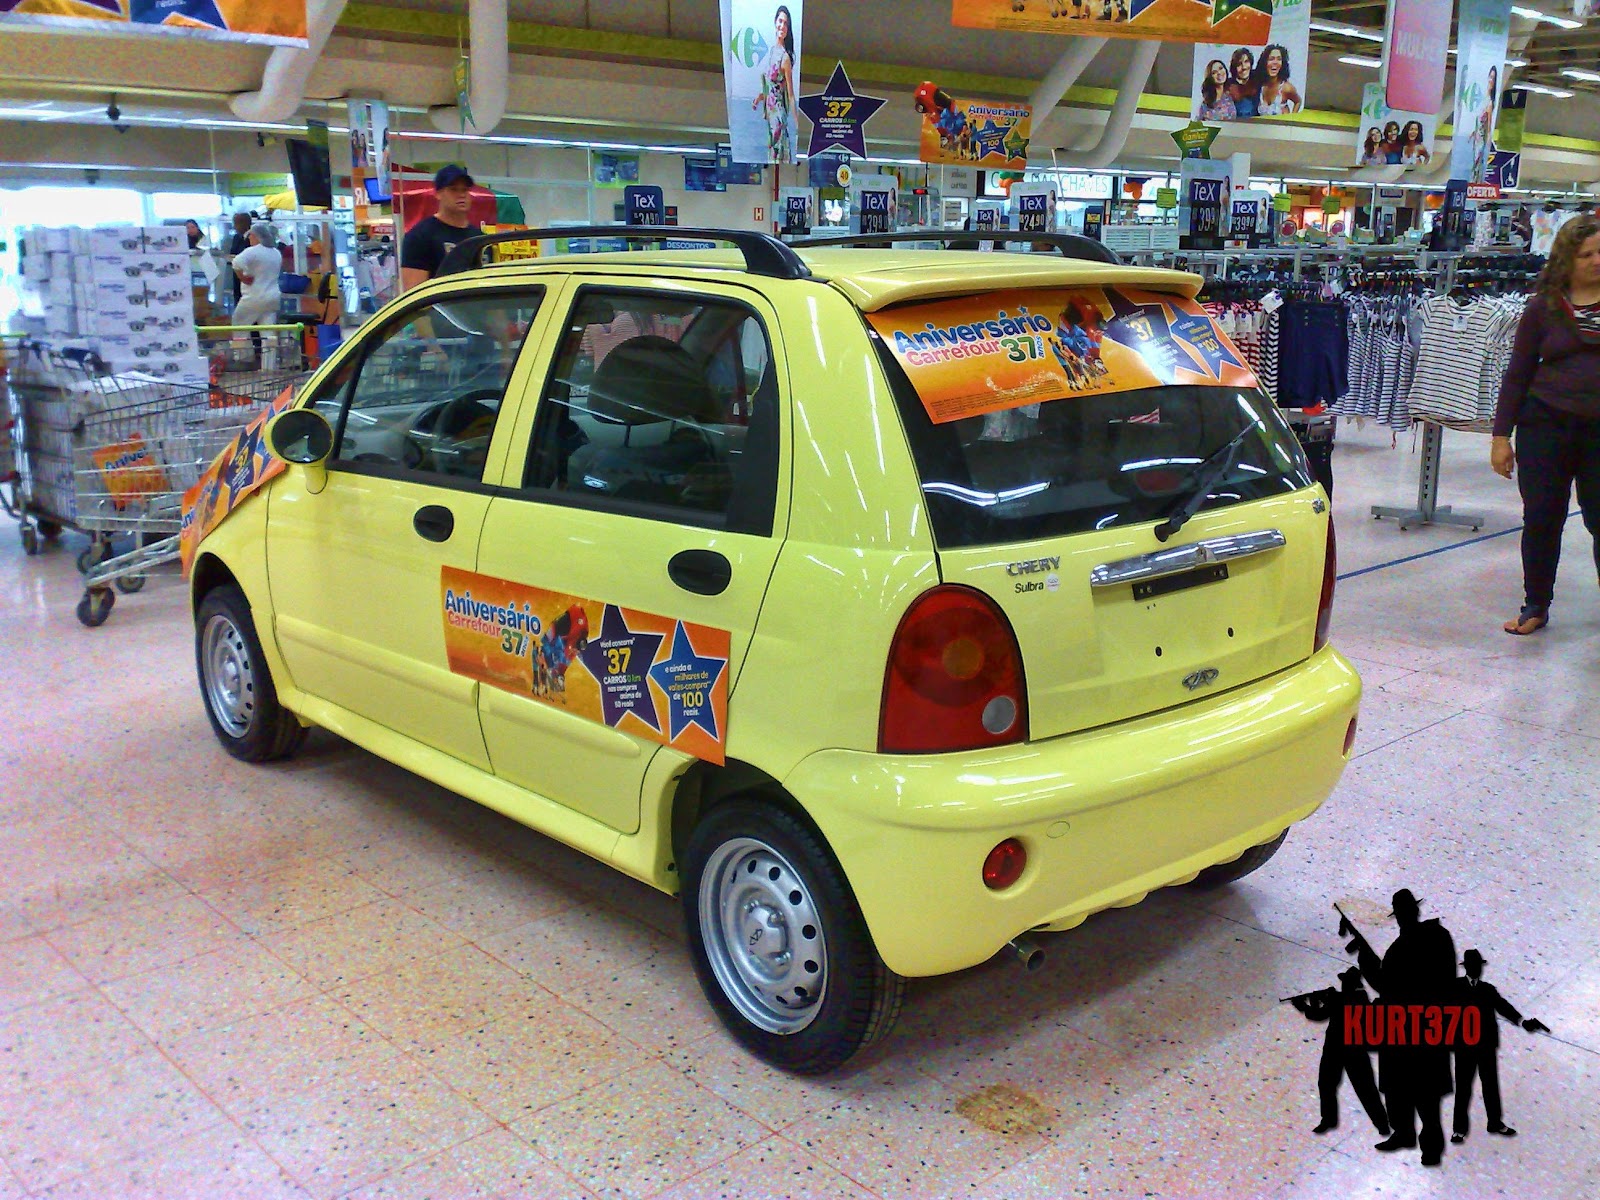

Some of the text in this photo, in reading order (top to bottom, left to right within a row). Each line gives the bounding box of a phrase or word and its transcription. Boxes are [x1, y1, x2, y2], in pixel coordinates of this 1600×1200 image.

[826, 101, 853, 118] 37
[968, 105, 1030, 118] Aniversário
[1004, 117, 1019, 127] 37
[1194, 182, 1216, 202] TeX
[1467, 186, 1498, 198] OFERTA
[633, 194, 656, 208] TeX
[789, 198, 805, 209] TeX
[864, 194, 886, 210] TeX
[1022, 197, 1043, 211] TeX
[1235, 202, 1254, 214] TeX
[893, 305, 1052, 353] Aniversário
[1129, 317, 1154, 342] 37
[905, 338, 1001, 366] Carrefour
[1000, 336, 1038, 364] 37
[1006, 556, 1060, 576] CHERY
[1015, 582, 1044, 593] Sulbra
[444, 589, 542, 636] Aniversário
[447, 610, 502, 638] Carrefour
[501, 628, 524, 656] 37
[607, 647, 631, 675] 37
[670, 663, 686, 672] ainda
[603, 675, 627, 684] CARROS
[682, 691, 704, 708] 100
